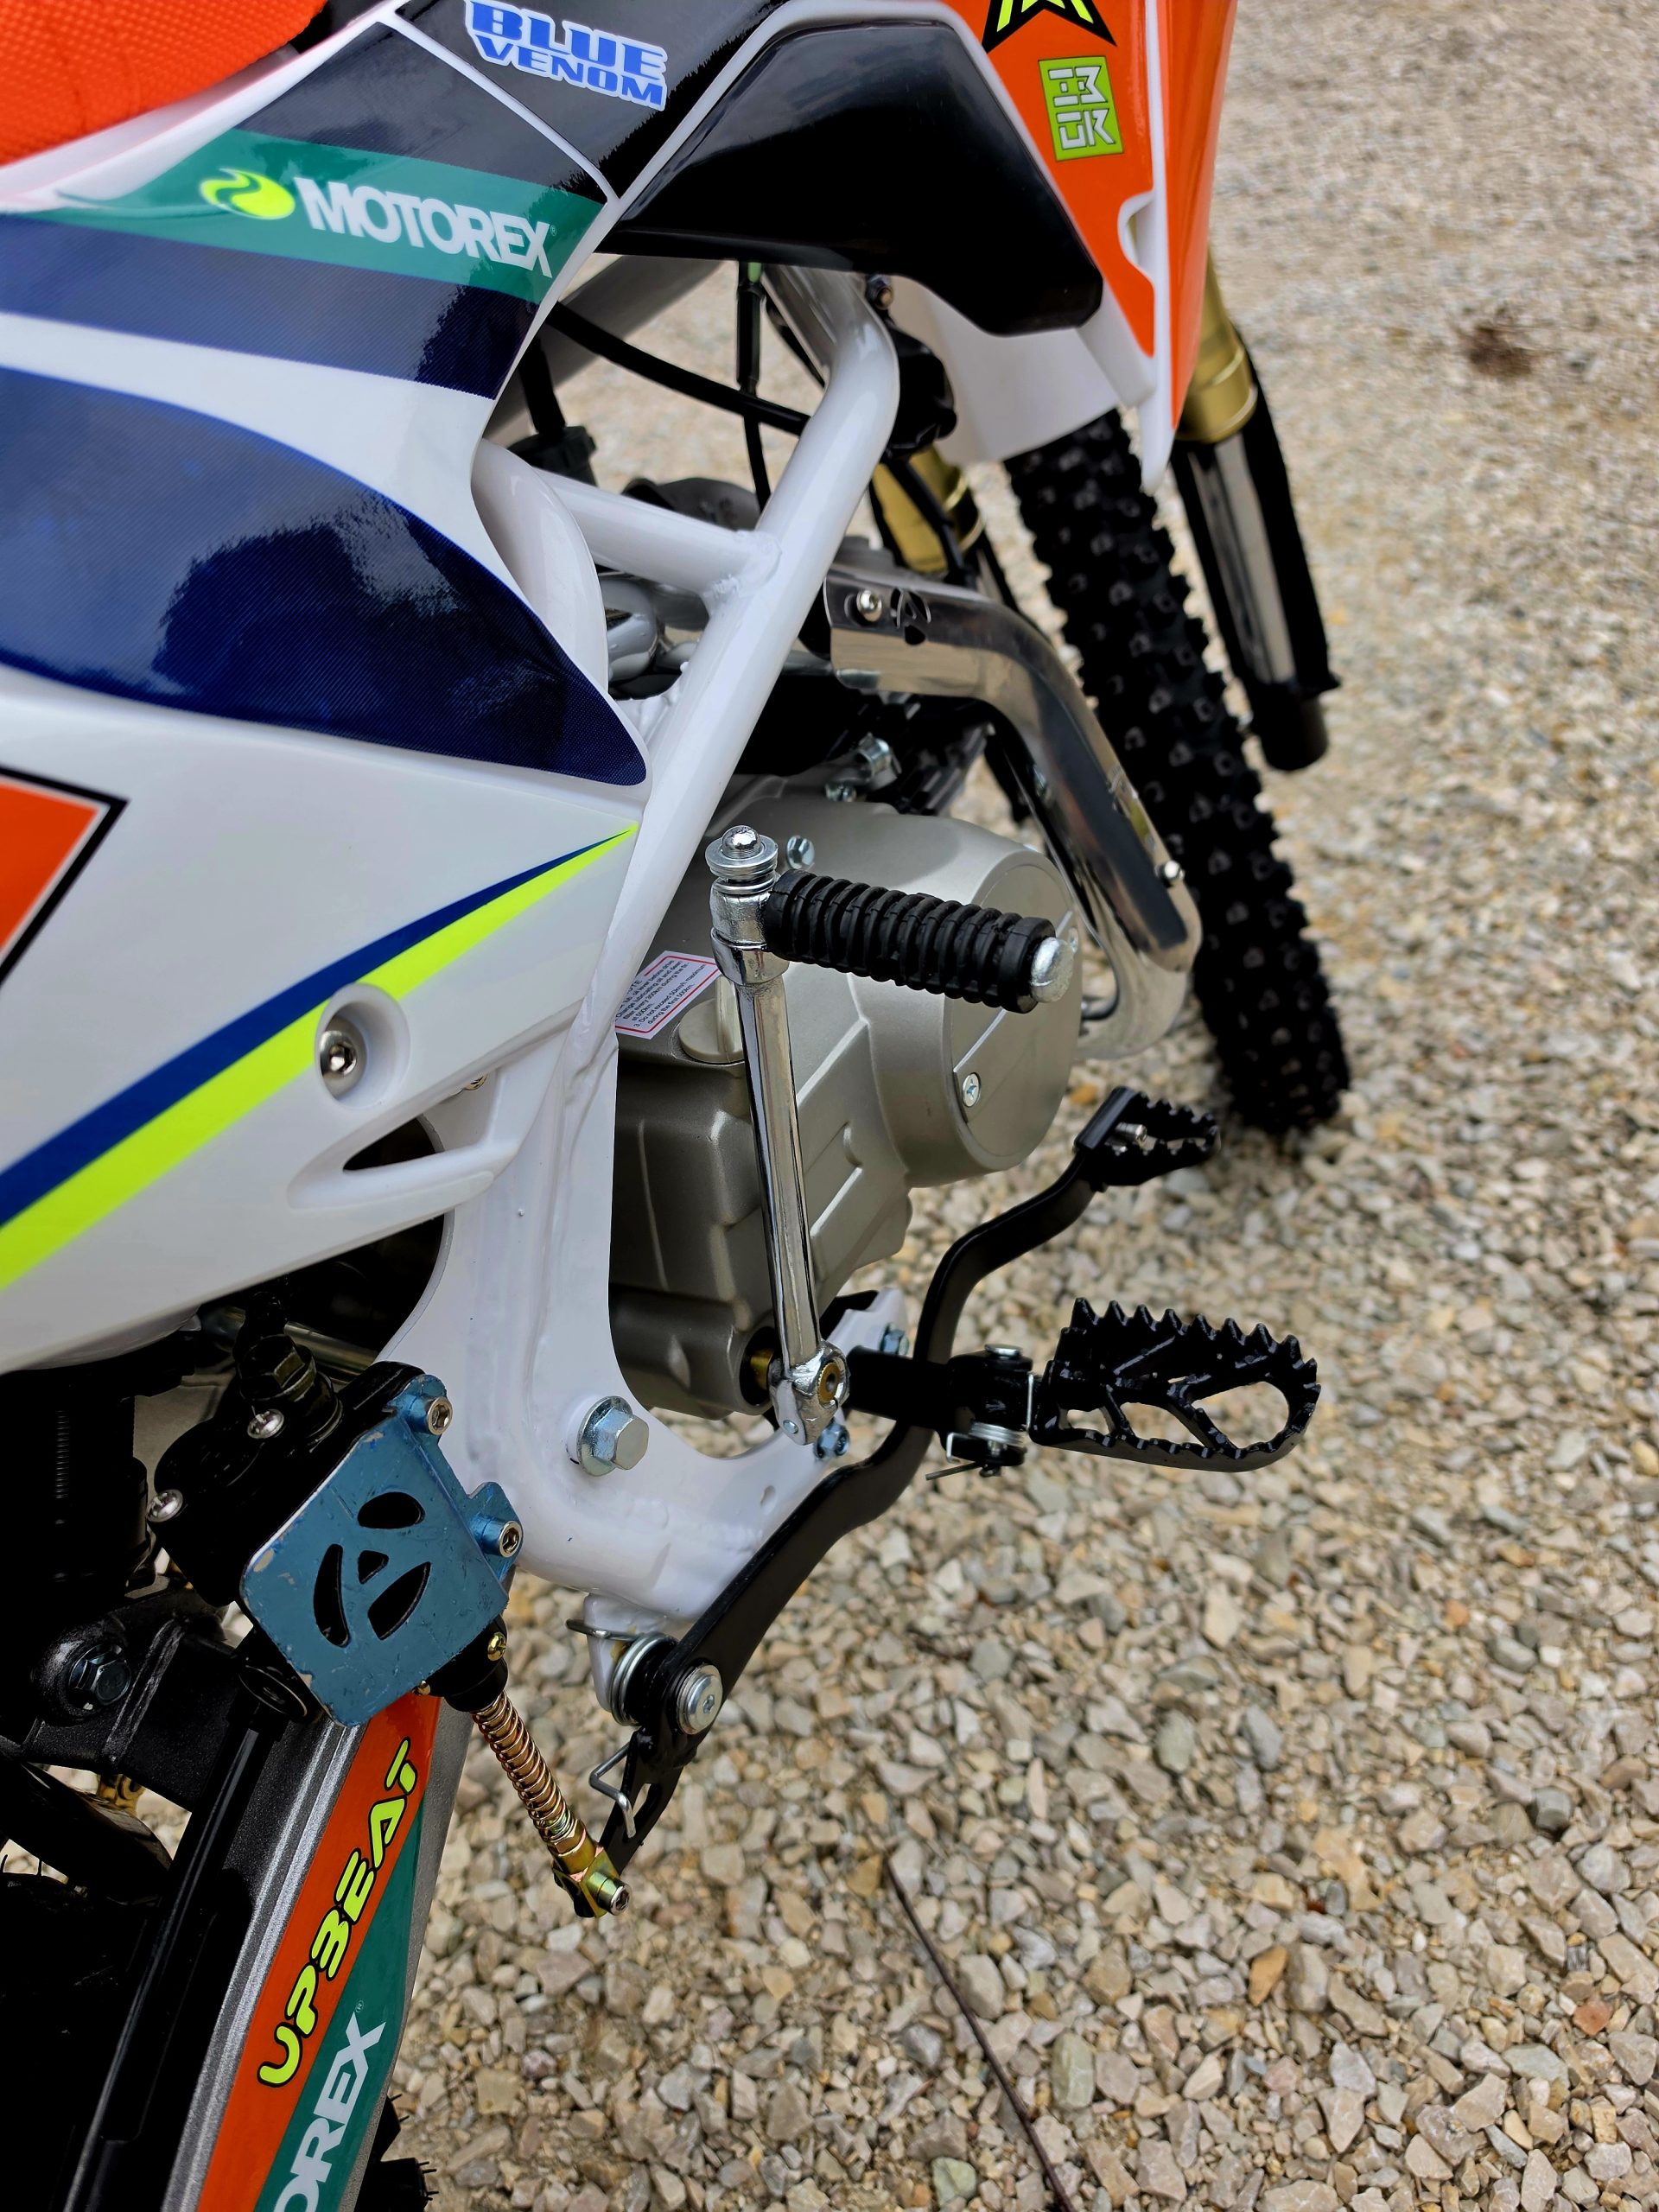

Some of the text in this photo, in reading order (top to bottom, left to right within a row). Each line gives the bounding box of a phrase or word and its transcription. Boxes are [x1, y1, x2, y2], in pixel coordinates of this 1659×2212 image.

[471, 1, 664, 81] BLUE
[475, 34, 664, 105] VENOM
[294, 176, 553, 277] MOTOREX
[634, 999, 649, 1010] every
[661, 974, 677, 986] during
[647, 1011, 664, 1024] during
[654, 995, 671, 1009] exceed
